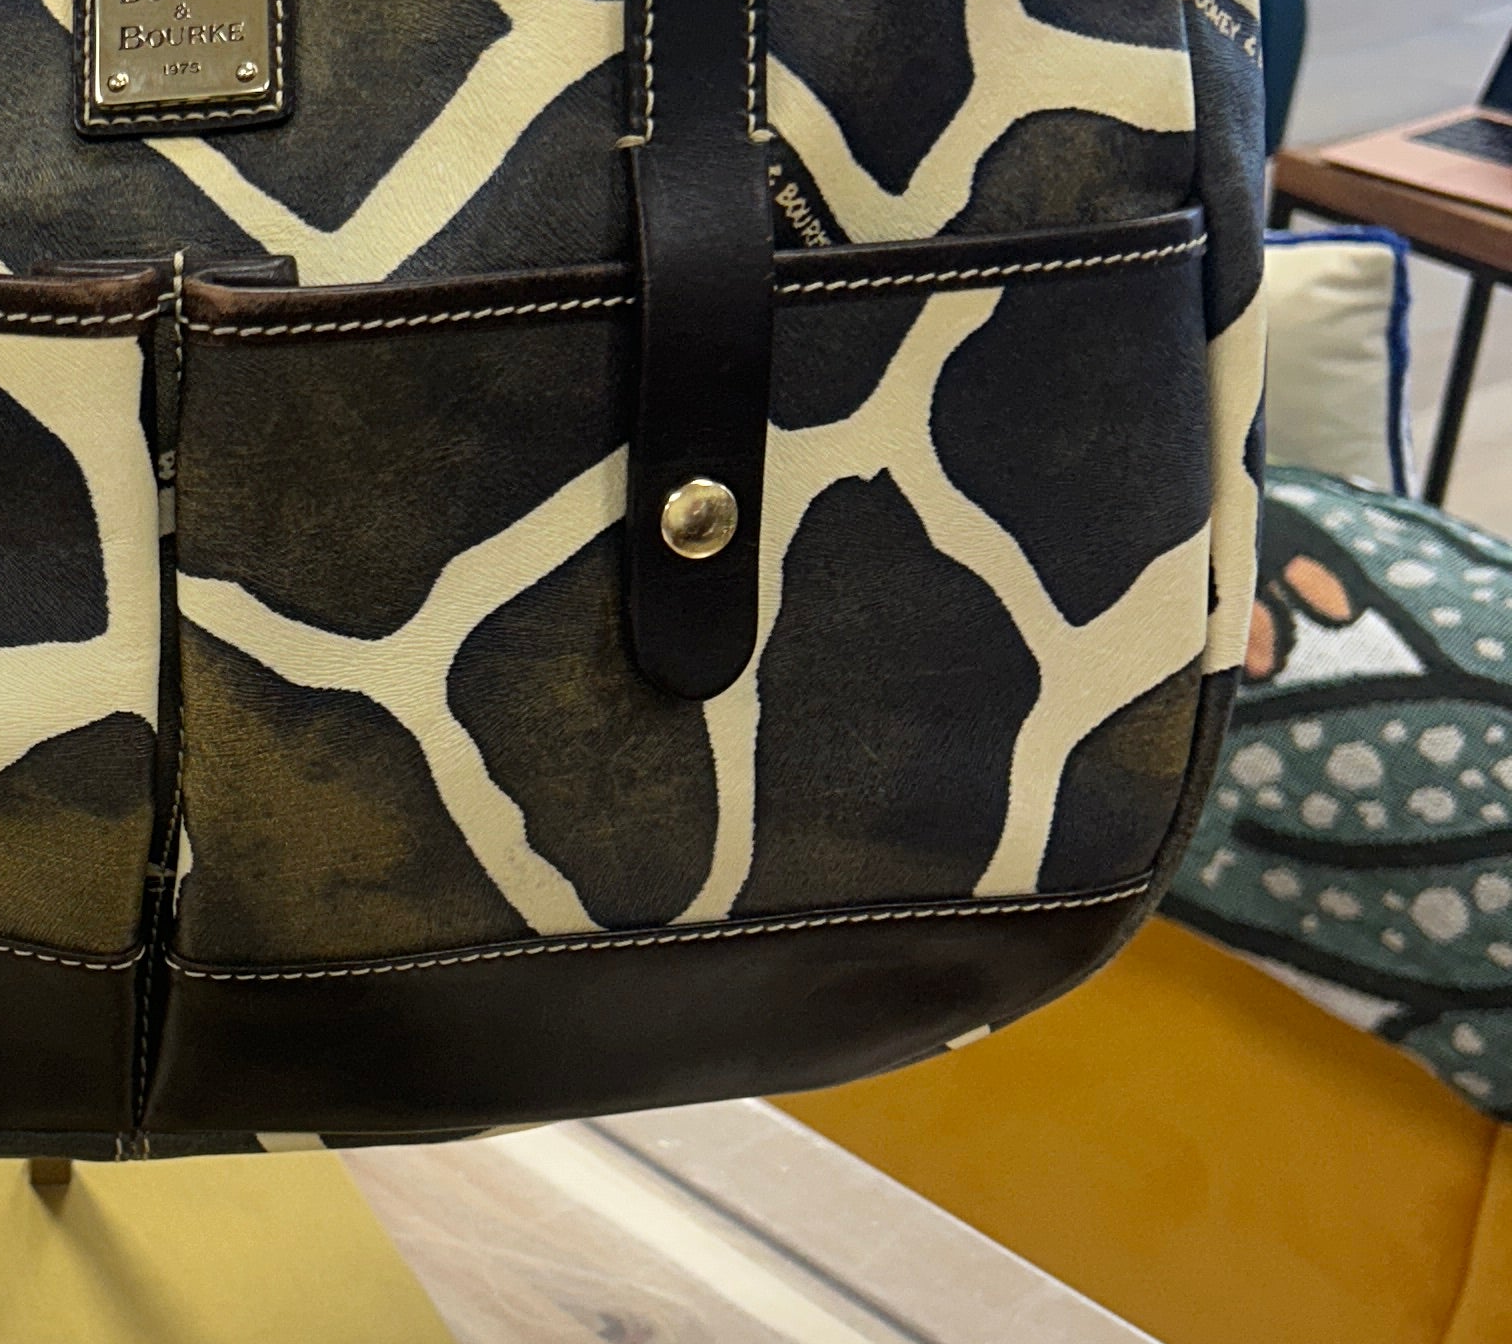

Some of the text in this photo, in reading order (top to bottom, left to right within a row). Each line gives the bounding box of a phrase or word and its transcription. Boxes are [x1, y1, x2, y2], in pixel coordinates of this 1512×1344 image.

[174, 2, 192, 21] &
[118, 20, 246, 52] BOURKE
[162, 61, 202, 77] 1975
